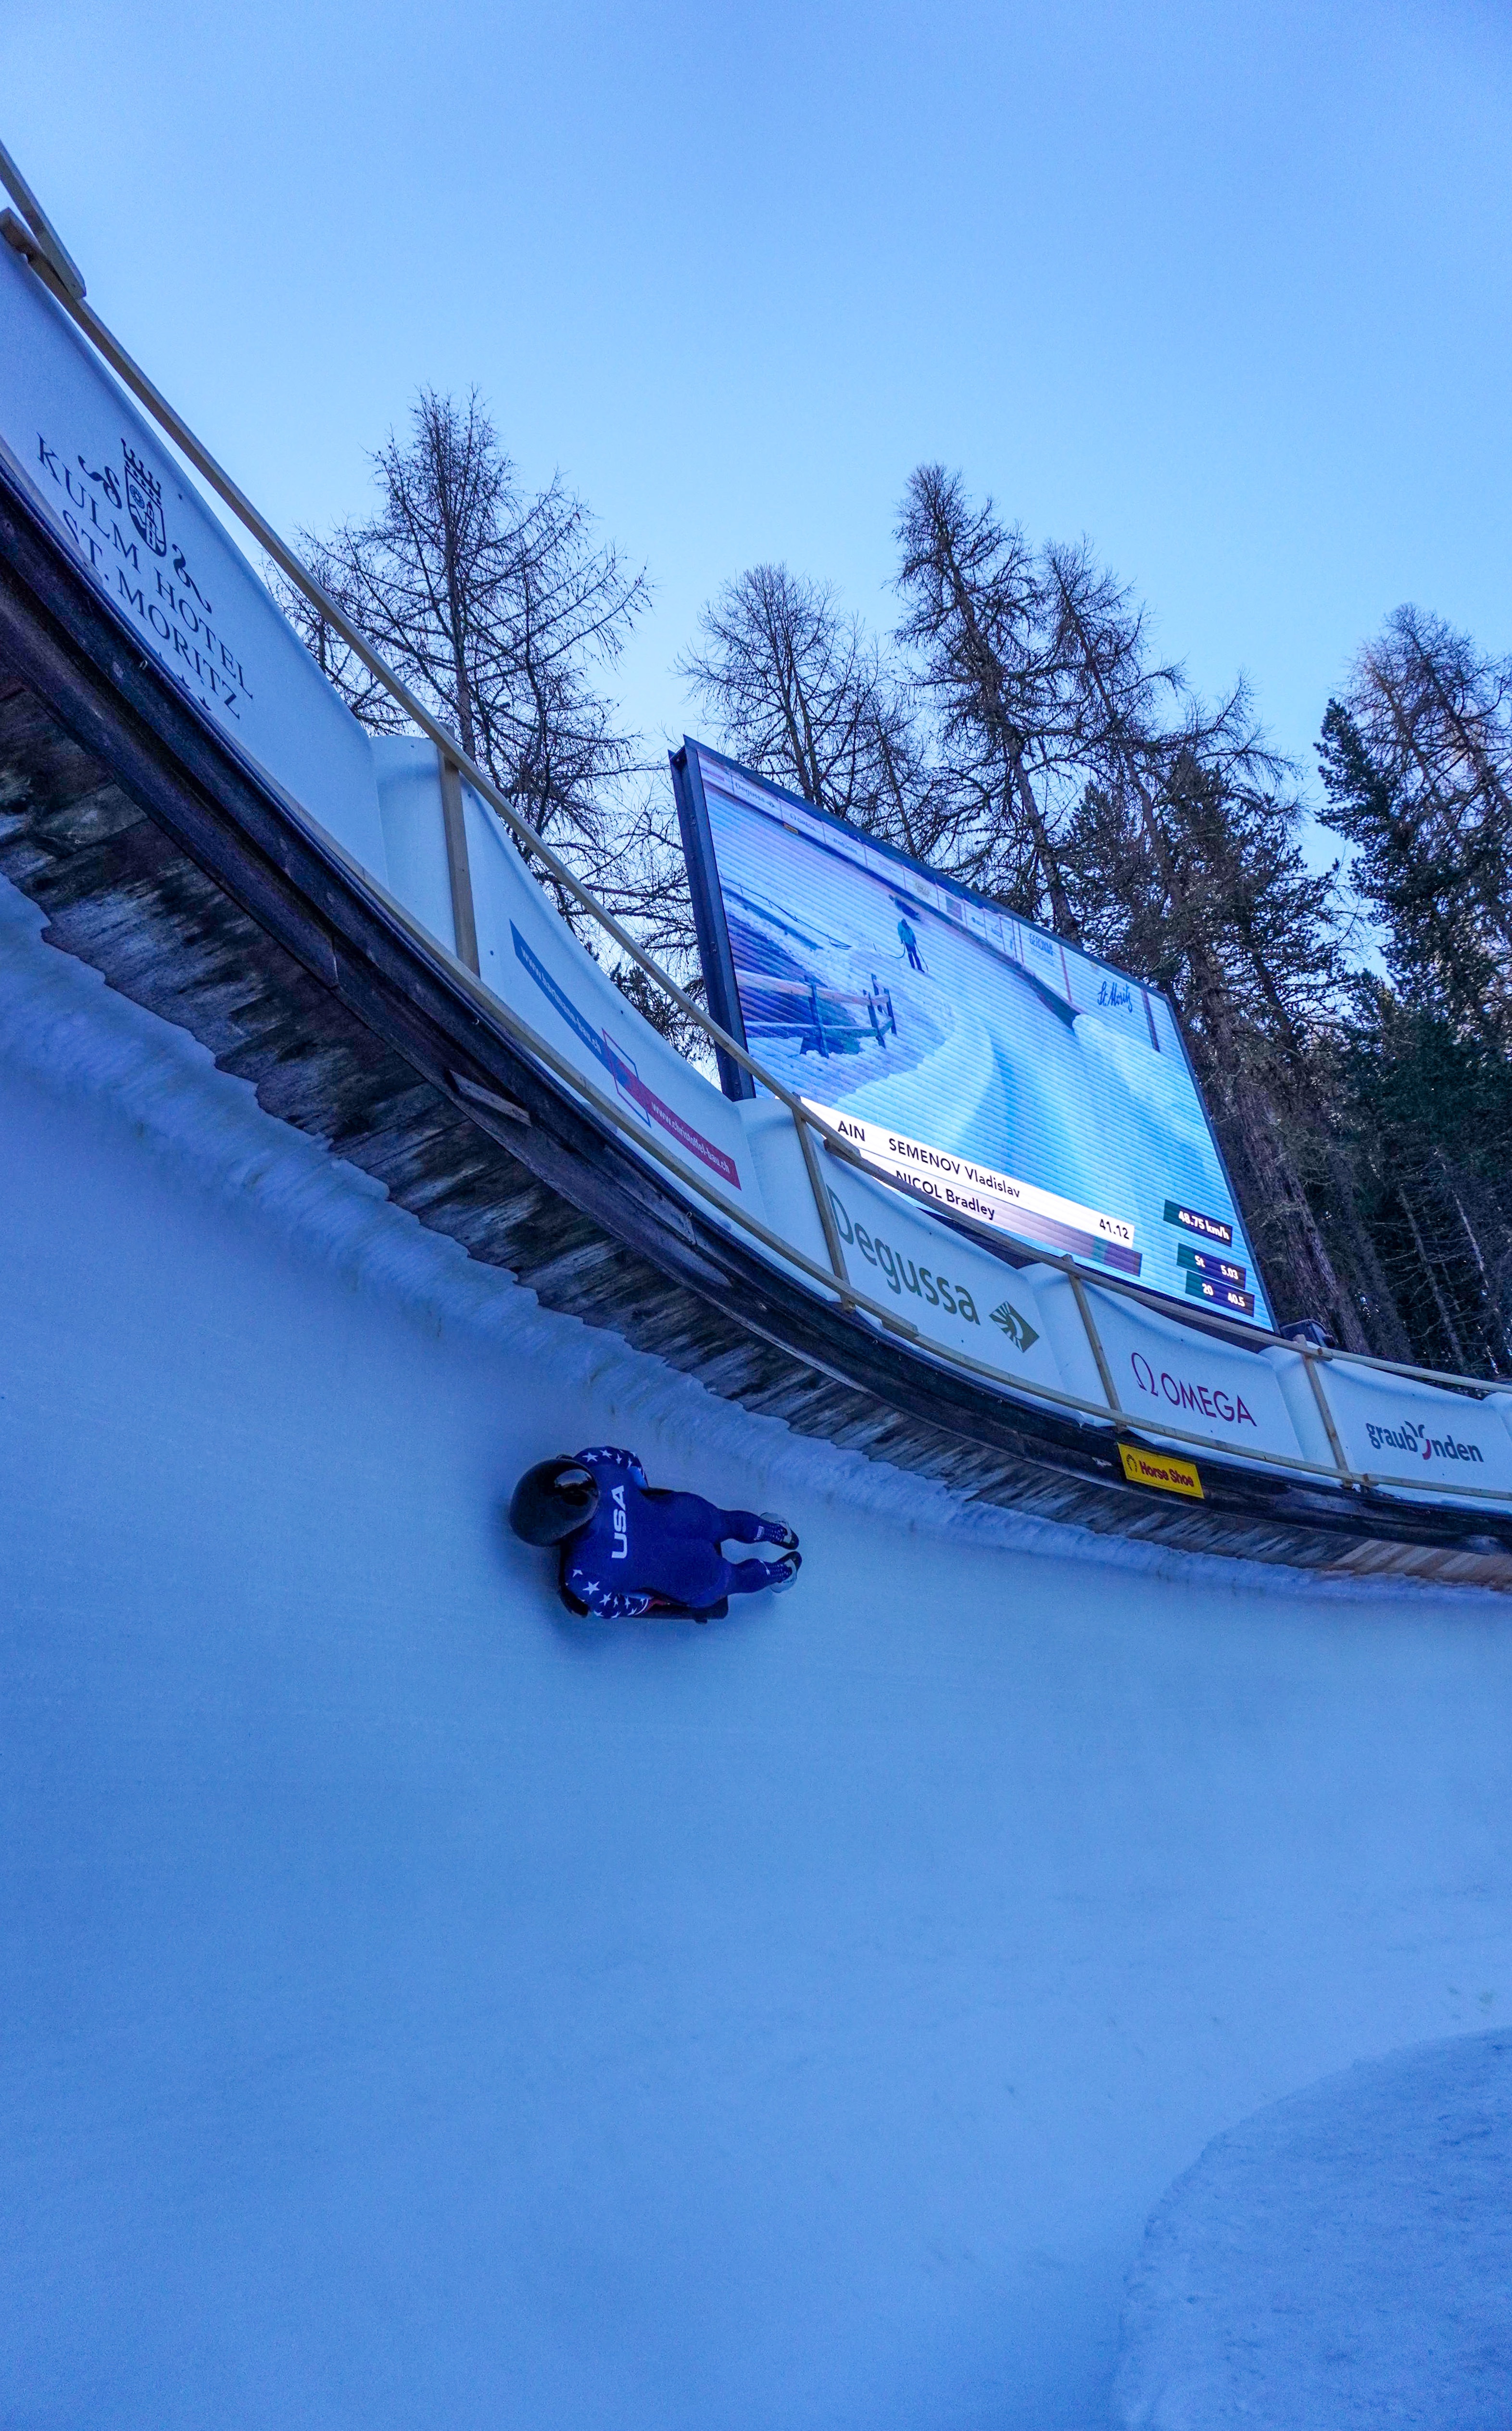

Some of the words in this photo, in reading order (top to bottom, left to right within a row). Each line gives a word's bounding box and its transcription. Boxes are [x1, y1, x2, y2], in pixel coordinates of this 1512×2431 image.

[36, 432, 140, 572] KULM
[153, 567, 253, 699] HOTEL
[116, 566, 240, 720] MORITZ
[651, 1102, 730, 1174] www.christoffel-bau.ch
[837, 1120, 865, 1142] AIN
[888, 1138, 960, 1175] SEMENOV
[964, 1165, 1020, 1198] Vladislav
[1099, 1218, 1130, 1240] 41.12
[945, 1188, 995, 1220] Bradley
[826, 1183, 981, 1326] Degussa
[1178, 1211, 1205, 1230] 48.75
[1205, 1220, 1230, 1240] km/h
[1202, 1283, 1214, 1296] 20
[1227, 1292, 1246, 1307] 40.5
[1220, 1265, 1239, 1280] 5.03
[1160, 1372, 1258, 1427] OMEGA
[1138, 1460, 1169, 1481] Horse
[1169, 1468, 1194, 1487] Shoe
[611, 1485, 628, 1559] USA
